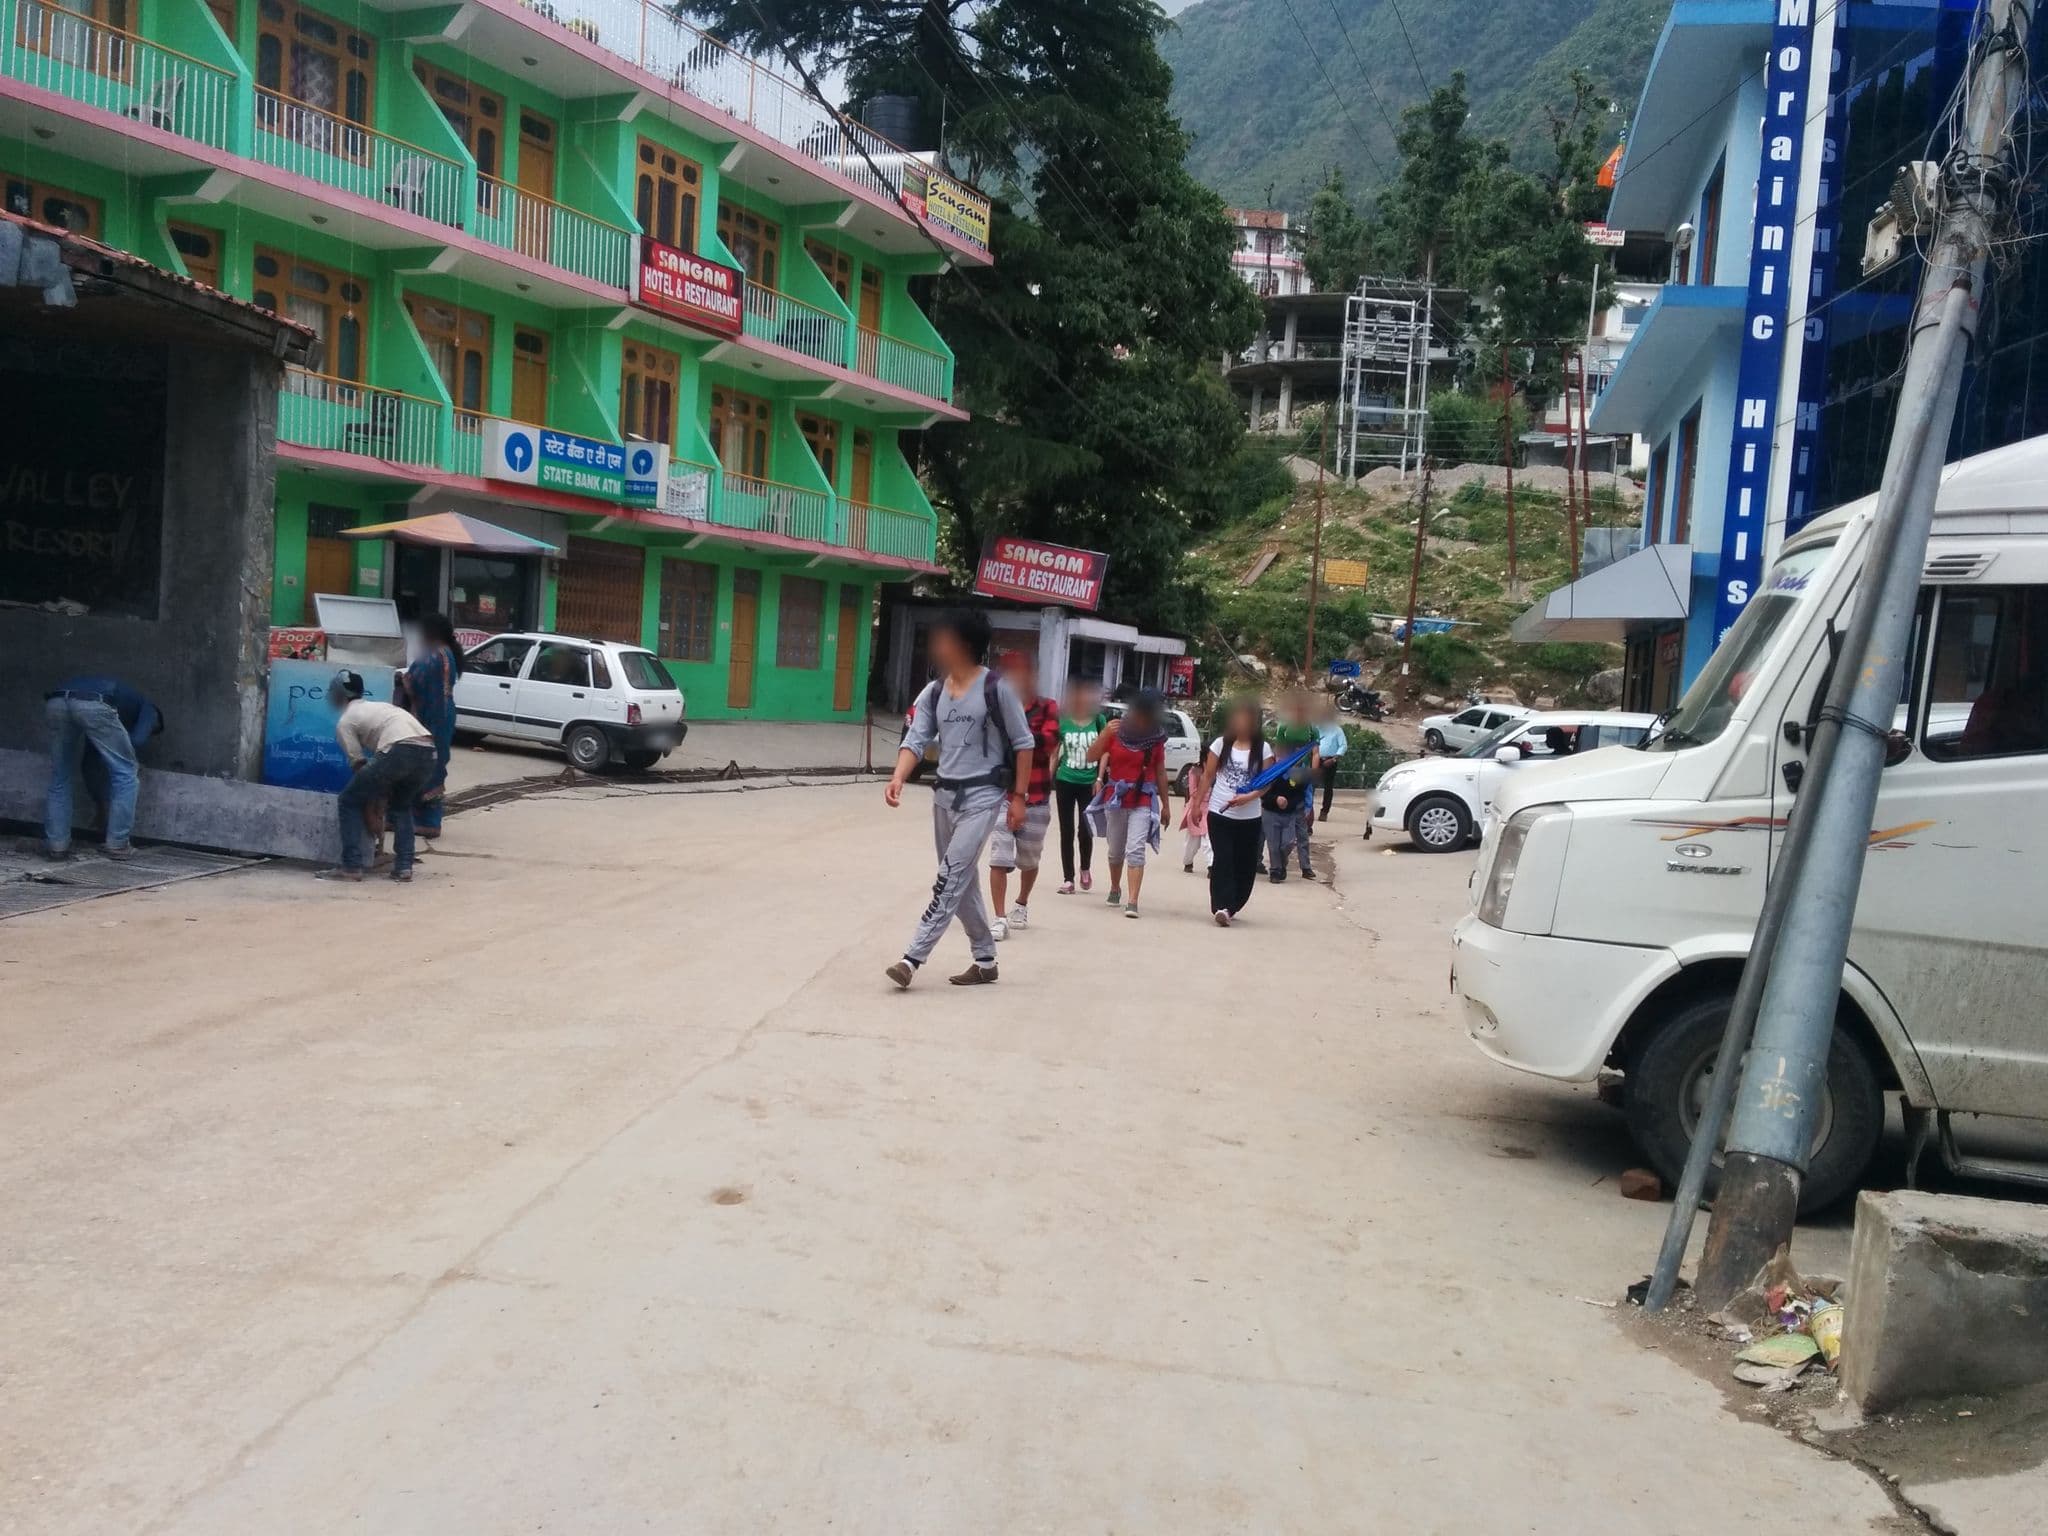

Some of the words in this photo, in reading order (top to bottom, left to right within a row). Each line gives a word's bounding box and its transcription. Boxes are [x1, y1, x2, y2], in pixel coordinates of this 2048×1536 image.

[1752, 0, 1810, 340] Morainic
[929, 181, 986, 225] Sangam
[929, 200, 946, 217] HOTEL
[953, 214, 984, 240] RESTAURANT
[928, 213, 952, 232] ROOMS
[953, 228, 985, 251] AVAILABLE
[659, 250, 727, 290] SANGAM
[645, 266, 674, 297] HOTEL
[676, 278, 683, 298] &
[684, 281, 738, 318] RESTAURANT
[545, 434, 565, 456] स्टेट
[567, 438, 585, 459] बैंक
[586, 448, 594, 464] ए
[595, 445, 606, 465] टी
[607, 453, 622, 469] एम
[543, 465, 573, 486] STATE
[575, 471, 601, 491] BANK
[602, 478, 621, 495] ATM
[1727, 399, 1767, 604] Hills
[1002, 543, 1084, 574] SANGAM
[983, 560, 1015, 584] HOTEL
[1018, 568, 1026, 586] &
[1027, 568, 1094, 600] RESTAURANT
[277, 631, 315, 642] Food
